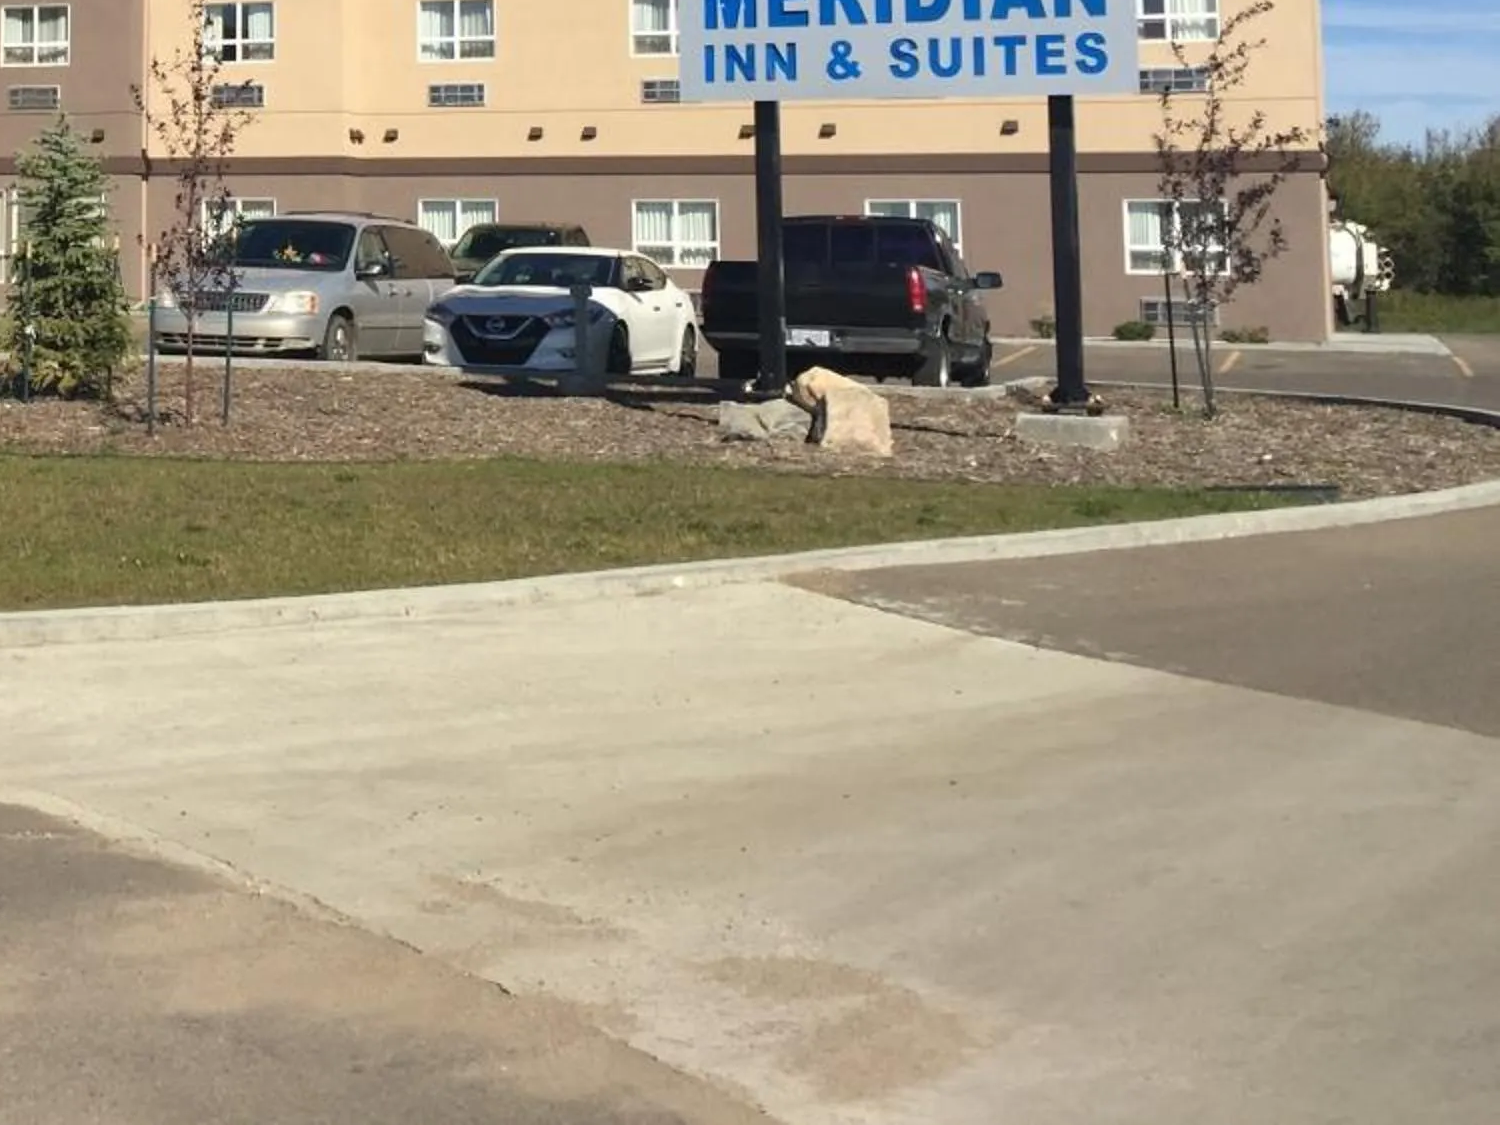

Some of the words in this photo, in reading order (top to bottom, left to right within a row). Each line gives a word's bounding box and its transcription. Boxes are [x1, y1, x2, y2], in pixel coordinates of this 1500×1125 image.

[704, 42, 798, 83] INN
[826, 39, 862, 81] &
[888, 31, 1109, 79] SUITES
